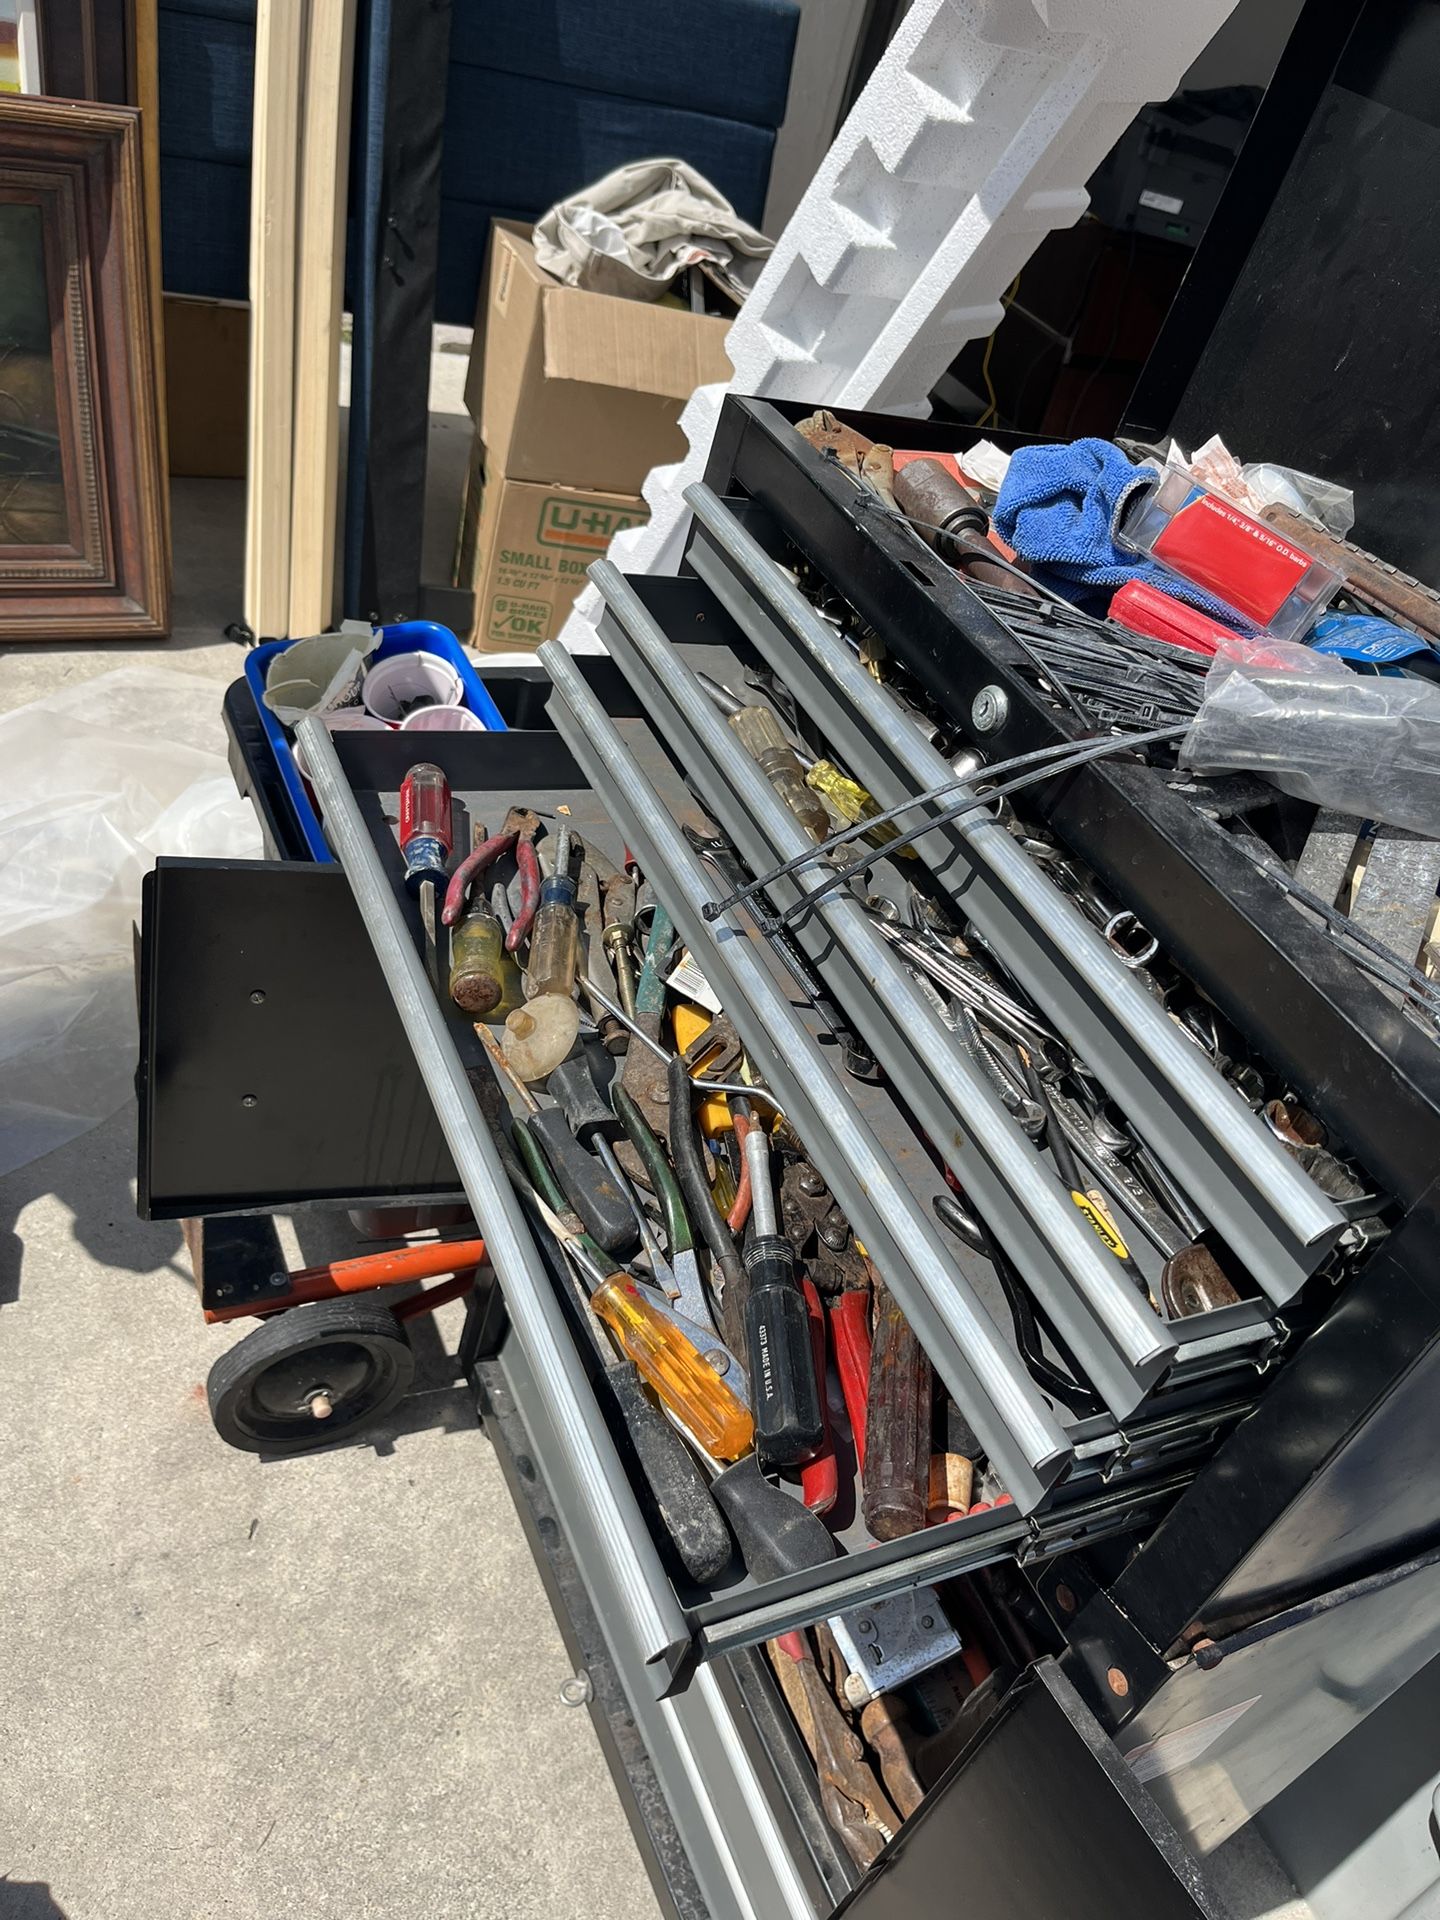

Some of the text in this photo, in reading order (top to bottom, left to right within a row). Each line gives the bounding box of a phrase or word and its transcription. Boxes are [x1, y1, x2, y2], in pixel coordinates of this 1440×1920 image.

[551, 506, 647, 536] U-HA
[1201, 498, 1227, 517] Includes
[1252, 530, 1260, 538] &
[1289, 553, 1307, 568] barbs
[499, 550, 588, 576] SMALL BOX
[512, 579, 526, 589] CU
[527, 581, 541, 590] FT
[511, 617, 544, 634] OK
[1080, 1205, 1119, 1249] STANLEY
[759, 1325, 768, 1346] 43373
[761, 1347, 771, 1369] MADE
[763, 1368, 771, 1378] IN
